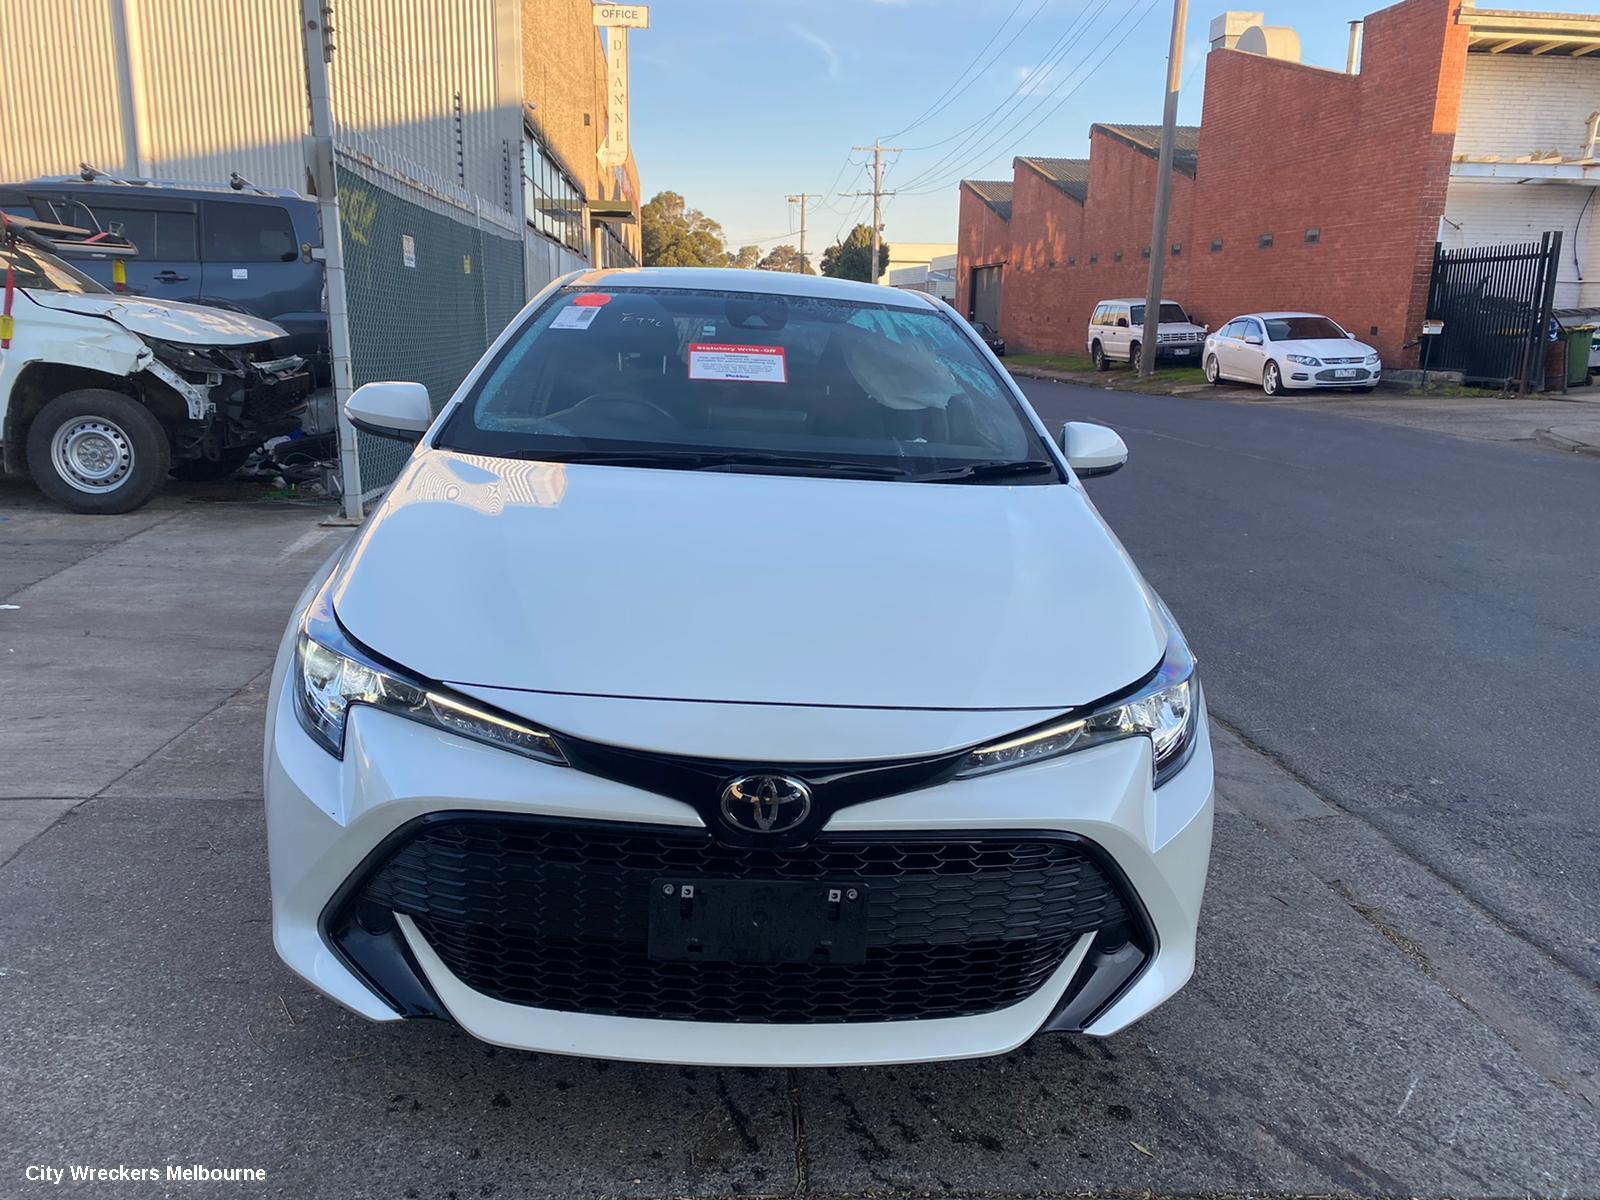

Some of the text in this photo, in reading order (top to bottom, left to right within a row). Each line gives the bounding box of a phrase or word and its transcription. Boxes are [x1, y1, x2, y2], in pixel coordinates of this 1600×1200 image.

[601, 9, 639, 19] OFFICE
[613, 39, 624, 142] DIANNE
[697, 345, 735, 353] Statutory
